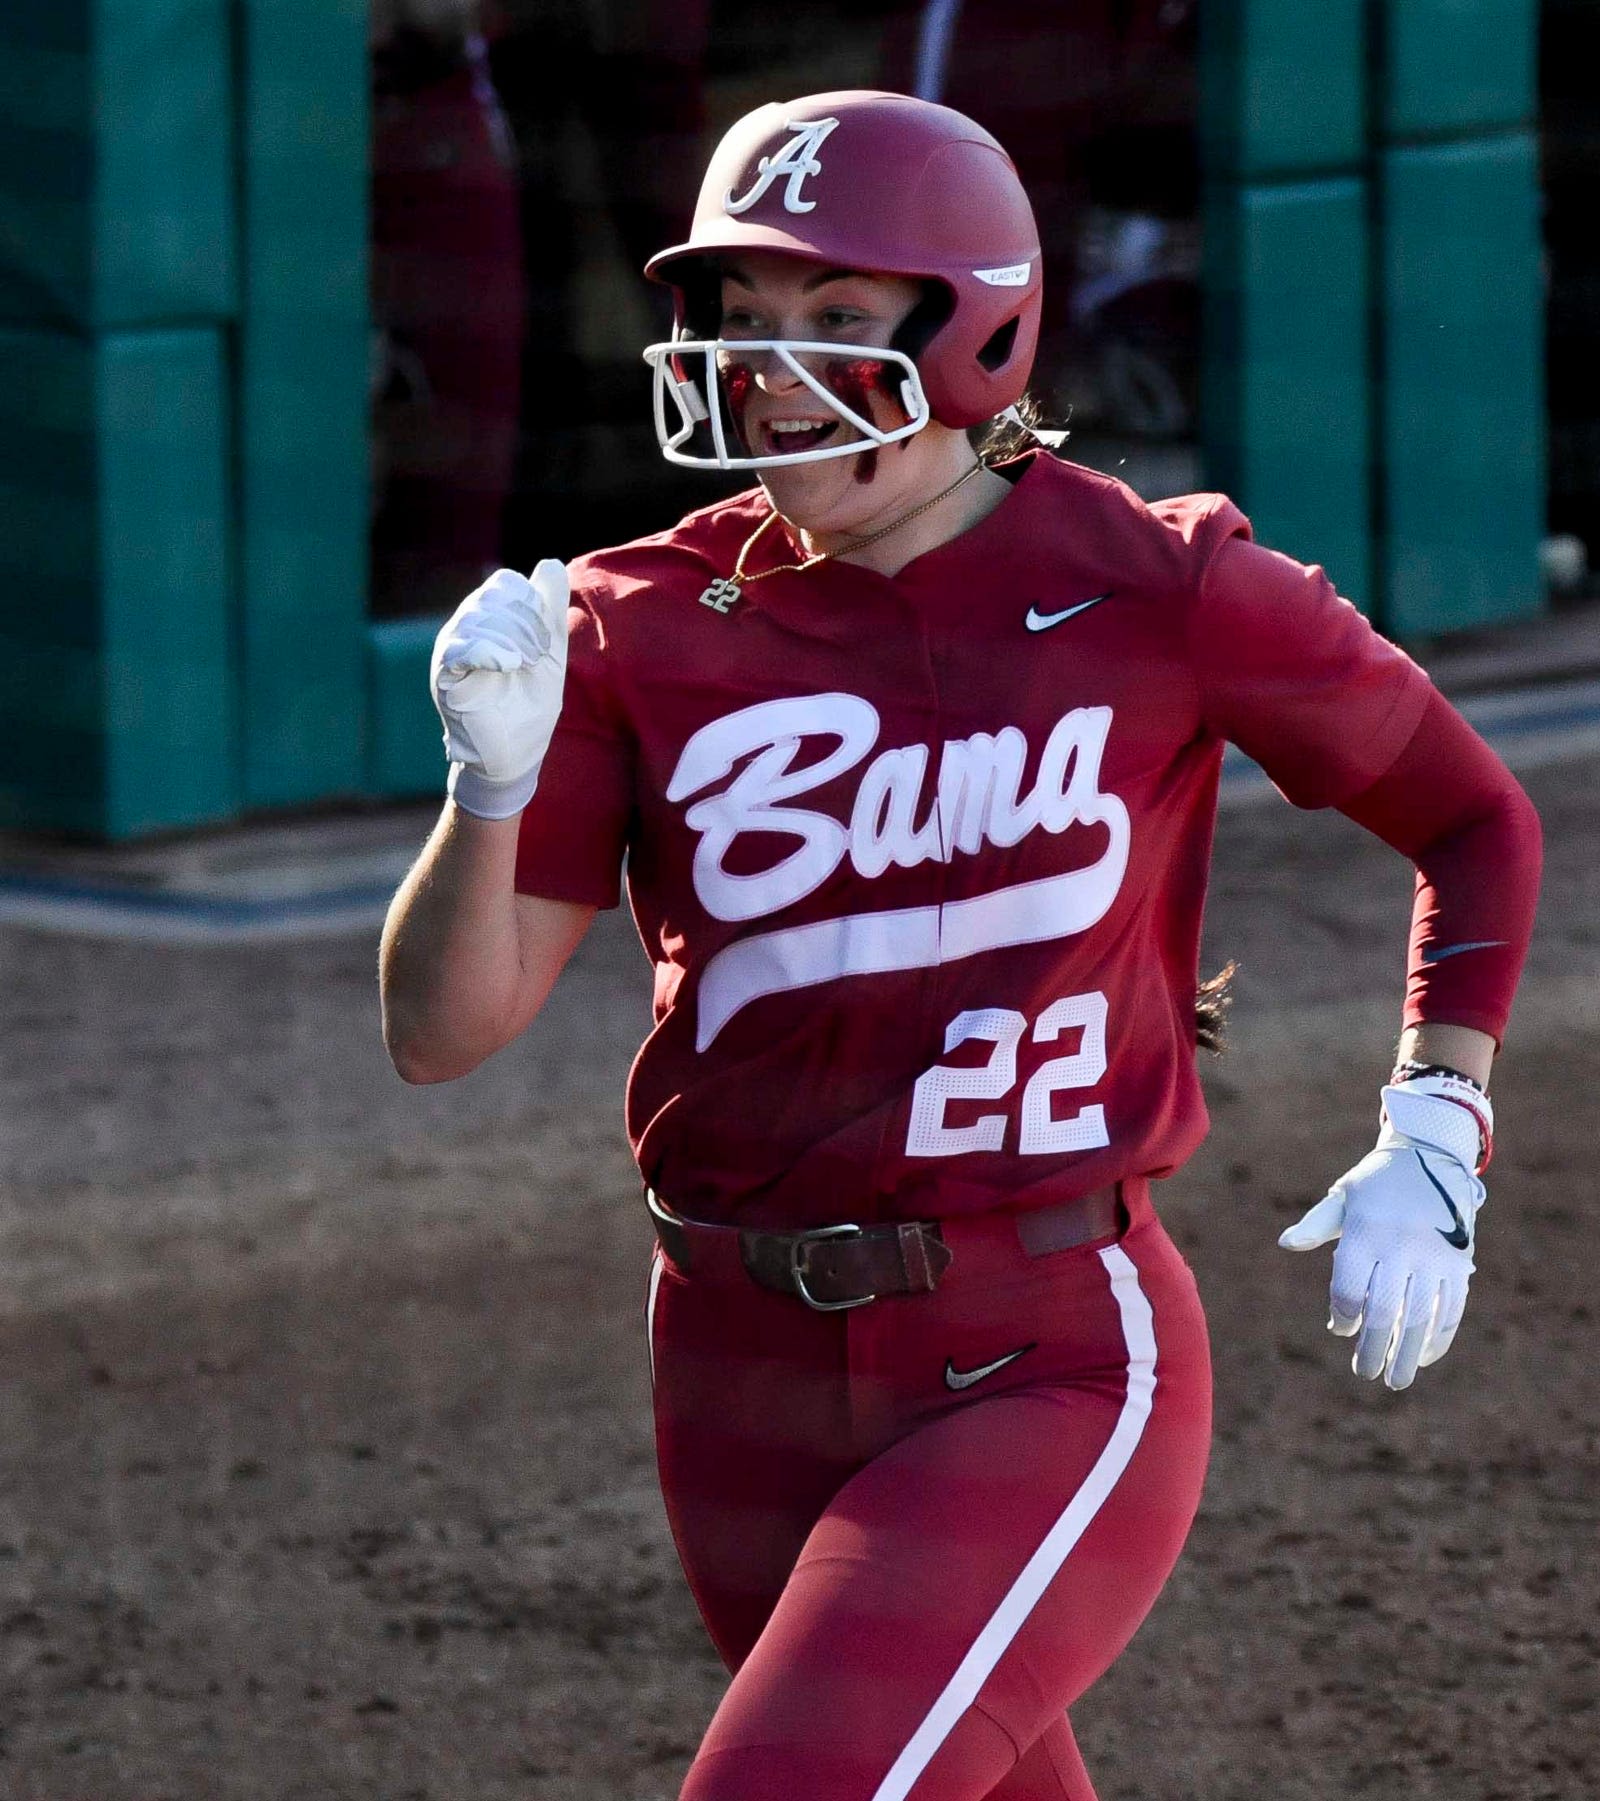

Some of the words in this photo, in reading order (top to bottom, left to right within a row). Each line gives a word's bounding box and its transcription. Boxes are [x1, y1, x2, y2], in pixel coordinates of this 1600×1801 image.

[723, 117, 840, 214] A
[699, 578, 741, 613] 22
[666, 692, 1131, 922] Bama
[905, 990, 1110, 1157] 22
